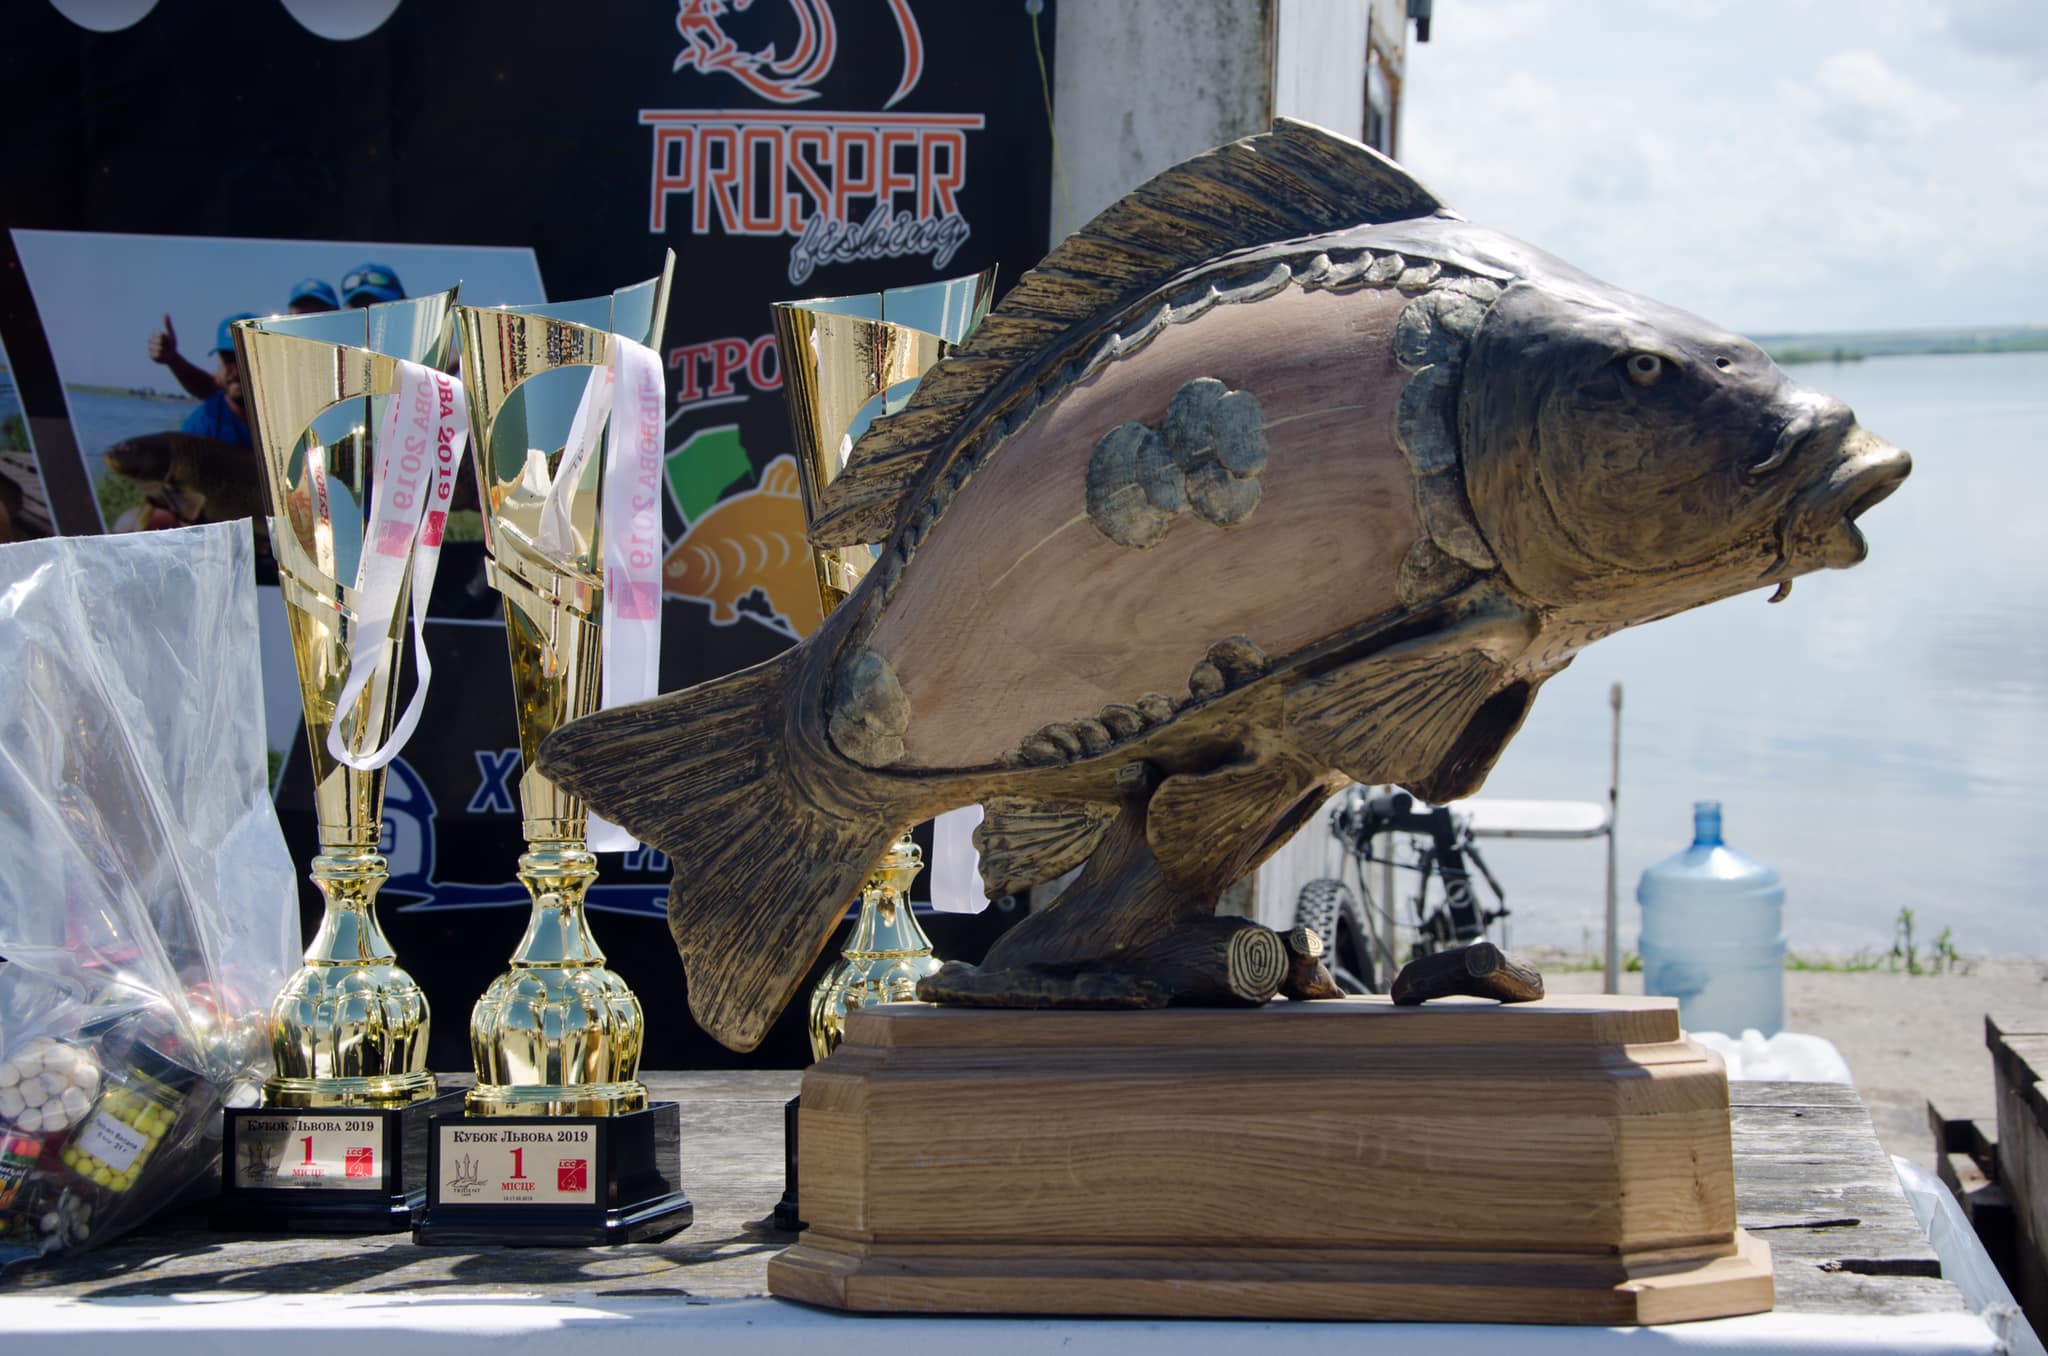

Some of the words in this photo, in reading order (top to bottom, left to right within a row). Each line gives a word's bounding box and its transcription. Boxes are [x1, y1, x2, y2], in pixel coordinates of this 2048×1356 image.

[788, 203, 970, 286] fishing
[669, 334, 784, 403] ТРО
[437, 425, 455, 501] 2019
[345, 1120, 374, 1132] 2019
[557, 1130, 588, 1143] 2019
[300, 1135, 317, 1166] 1
[509, 1147, 527, 1179] 1
[501, 1182, 536, 1192] МІСЦЕ
